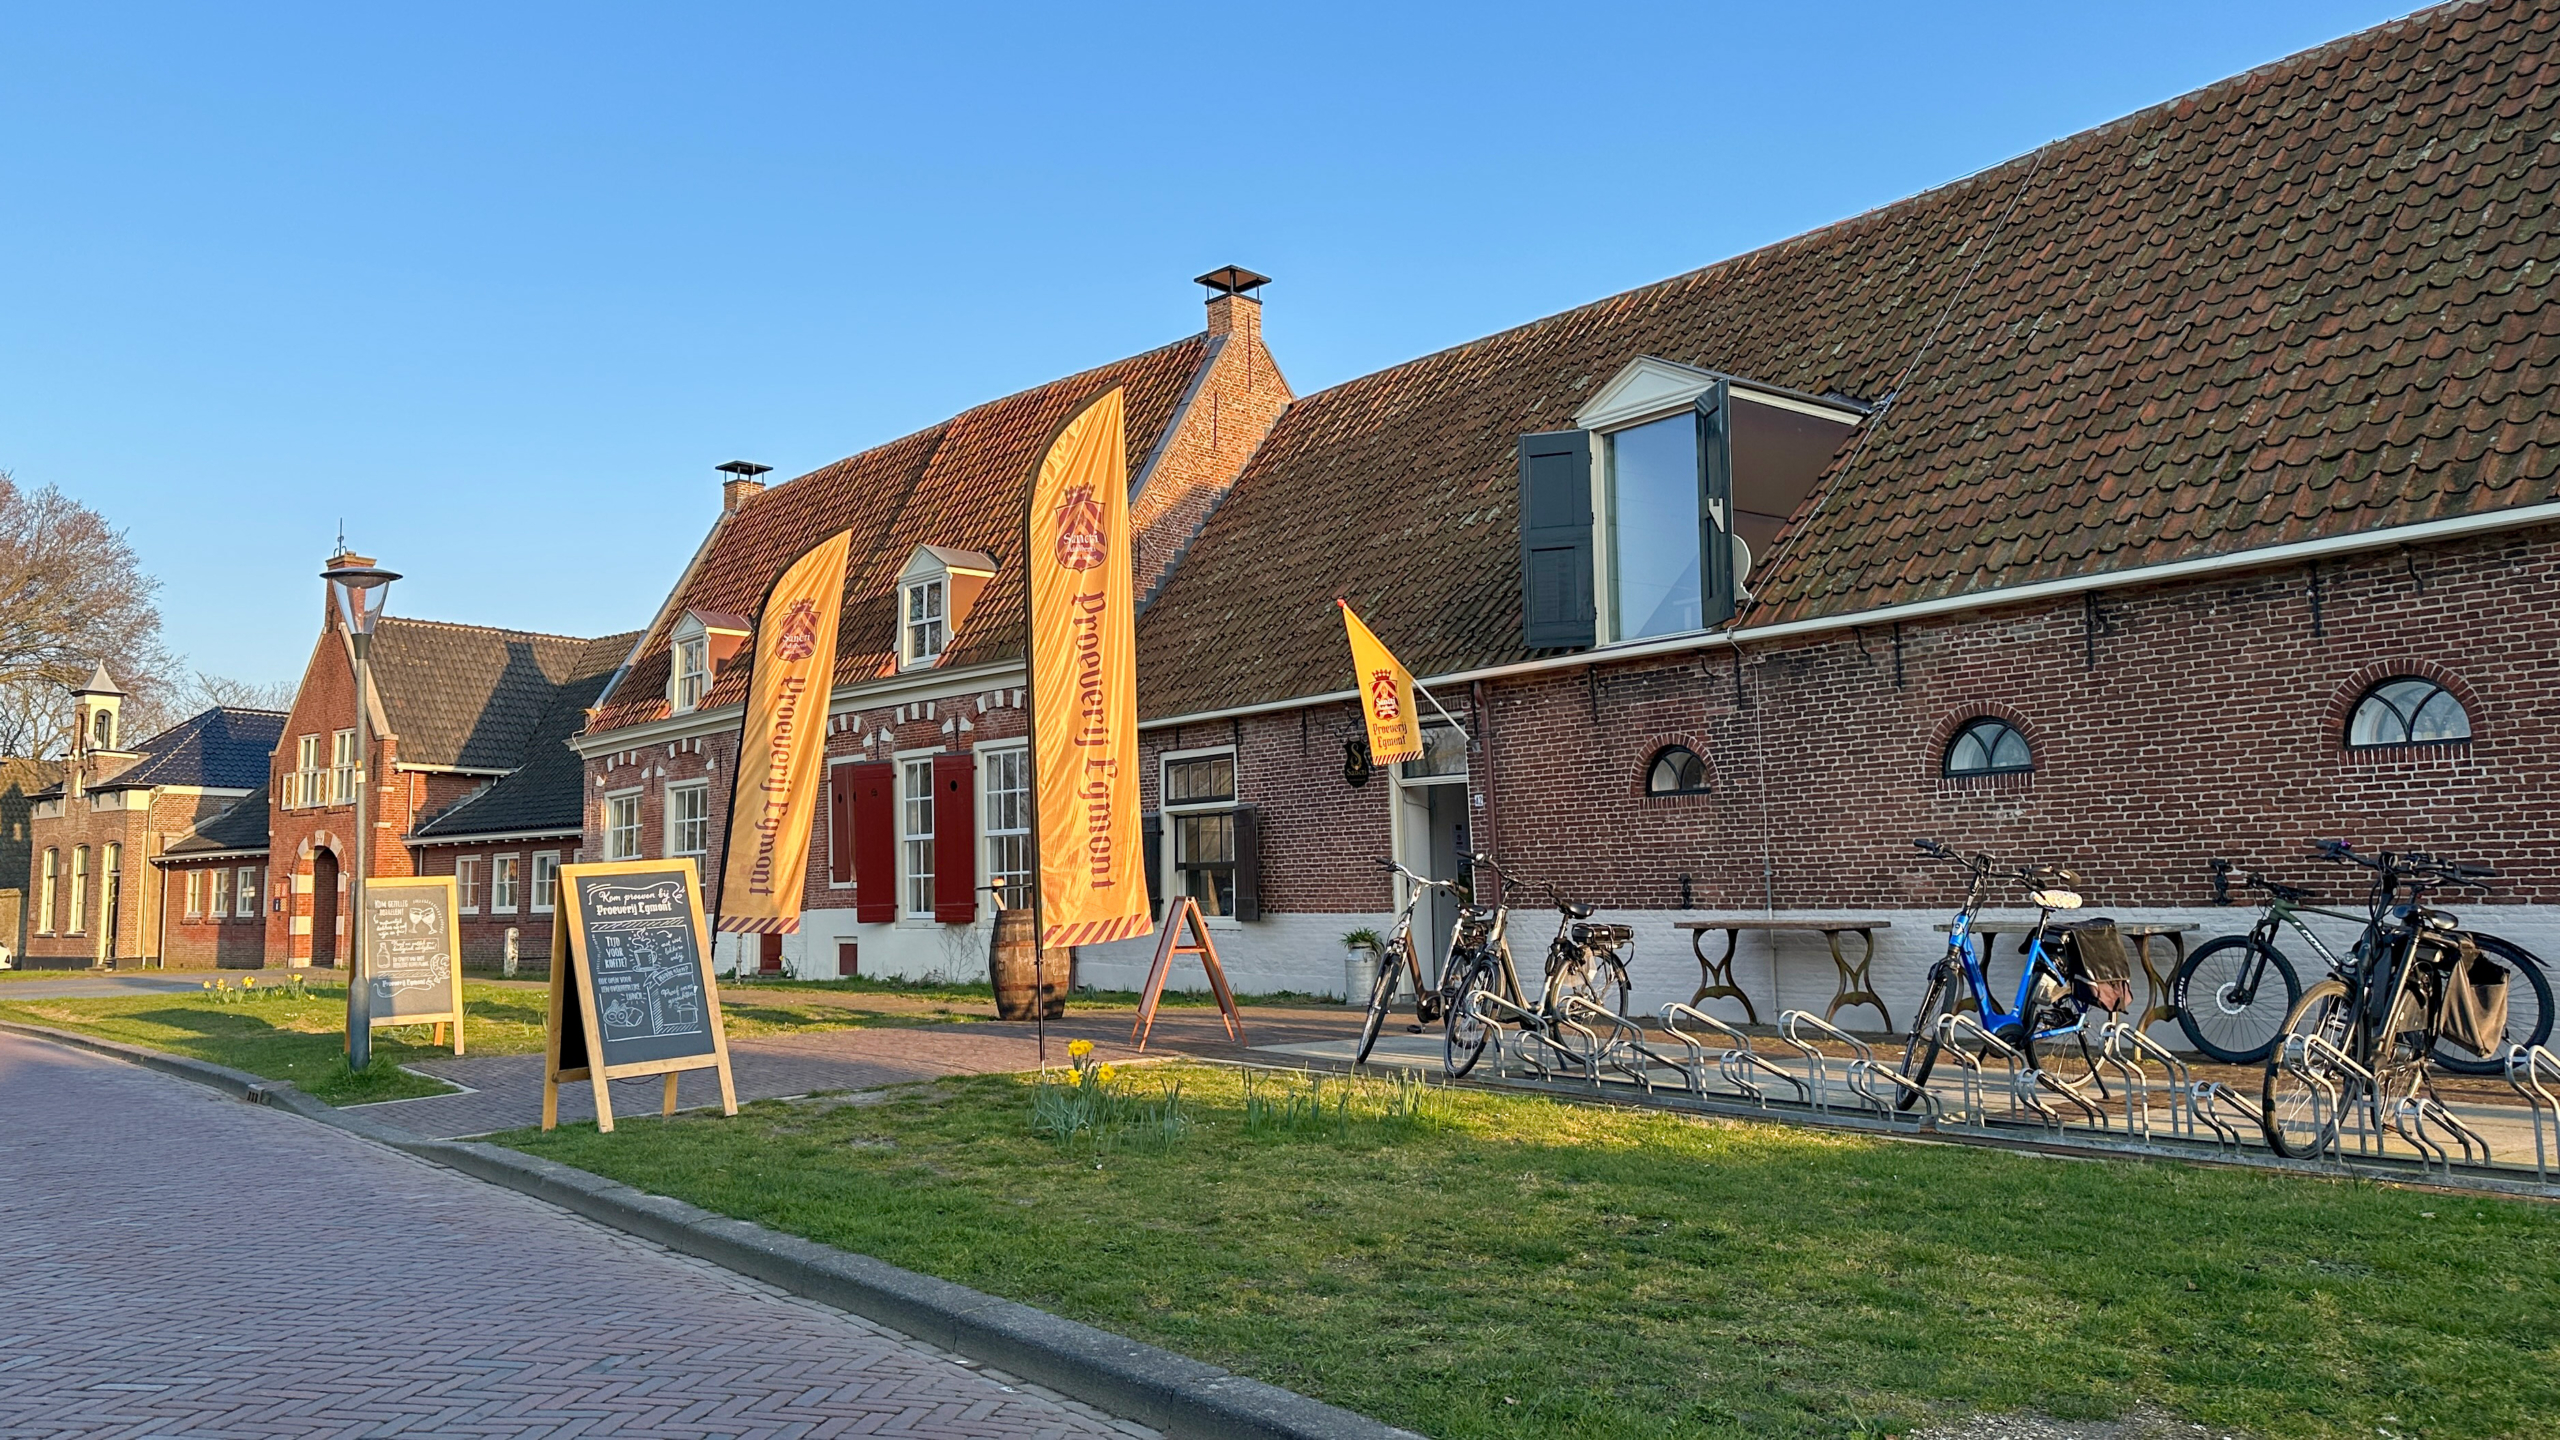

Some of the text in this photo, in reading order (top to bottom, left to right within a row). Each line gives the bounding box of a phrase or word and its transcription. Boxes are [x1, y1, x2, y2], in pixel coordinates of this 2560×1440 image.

[1063, 531, 1099, 544] Sancti
[783, 631, 811, 642] Sancti
[1071, 590, 1112, 747] Proeverij
[760, 675, 806, 793] Proeverij
[1372, 721, 1407, 735] Proeverij
[1377, 735, 1406, 750] Egmont
[1077, 757, 1118, 892] Egmont
[748, 799, 789, 897] Egmont
[599, 888, 670, 905] Kom proeven bij
[596, 901, 673, 916] Proeverij Egmont
[605, 936, 621, 948] TIJD
[605, 947, 625, 958] VOOR
[2178, 976, 2186, 1008] MAXXIS
